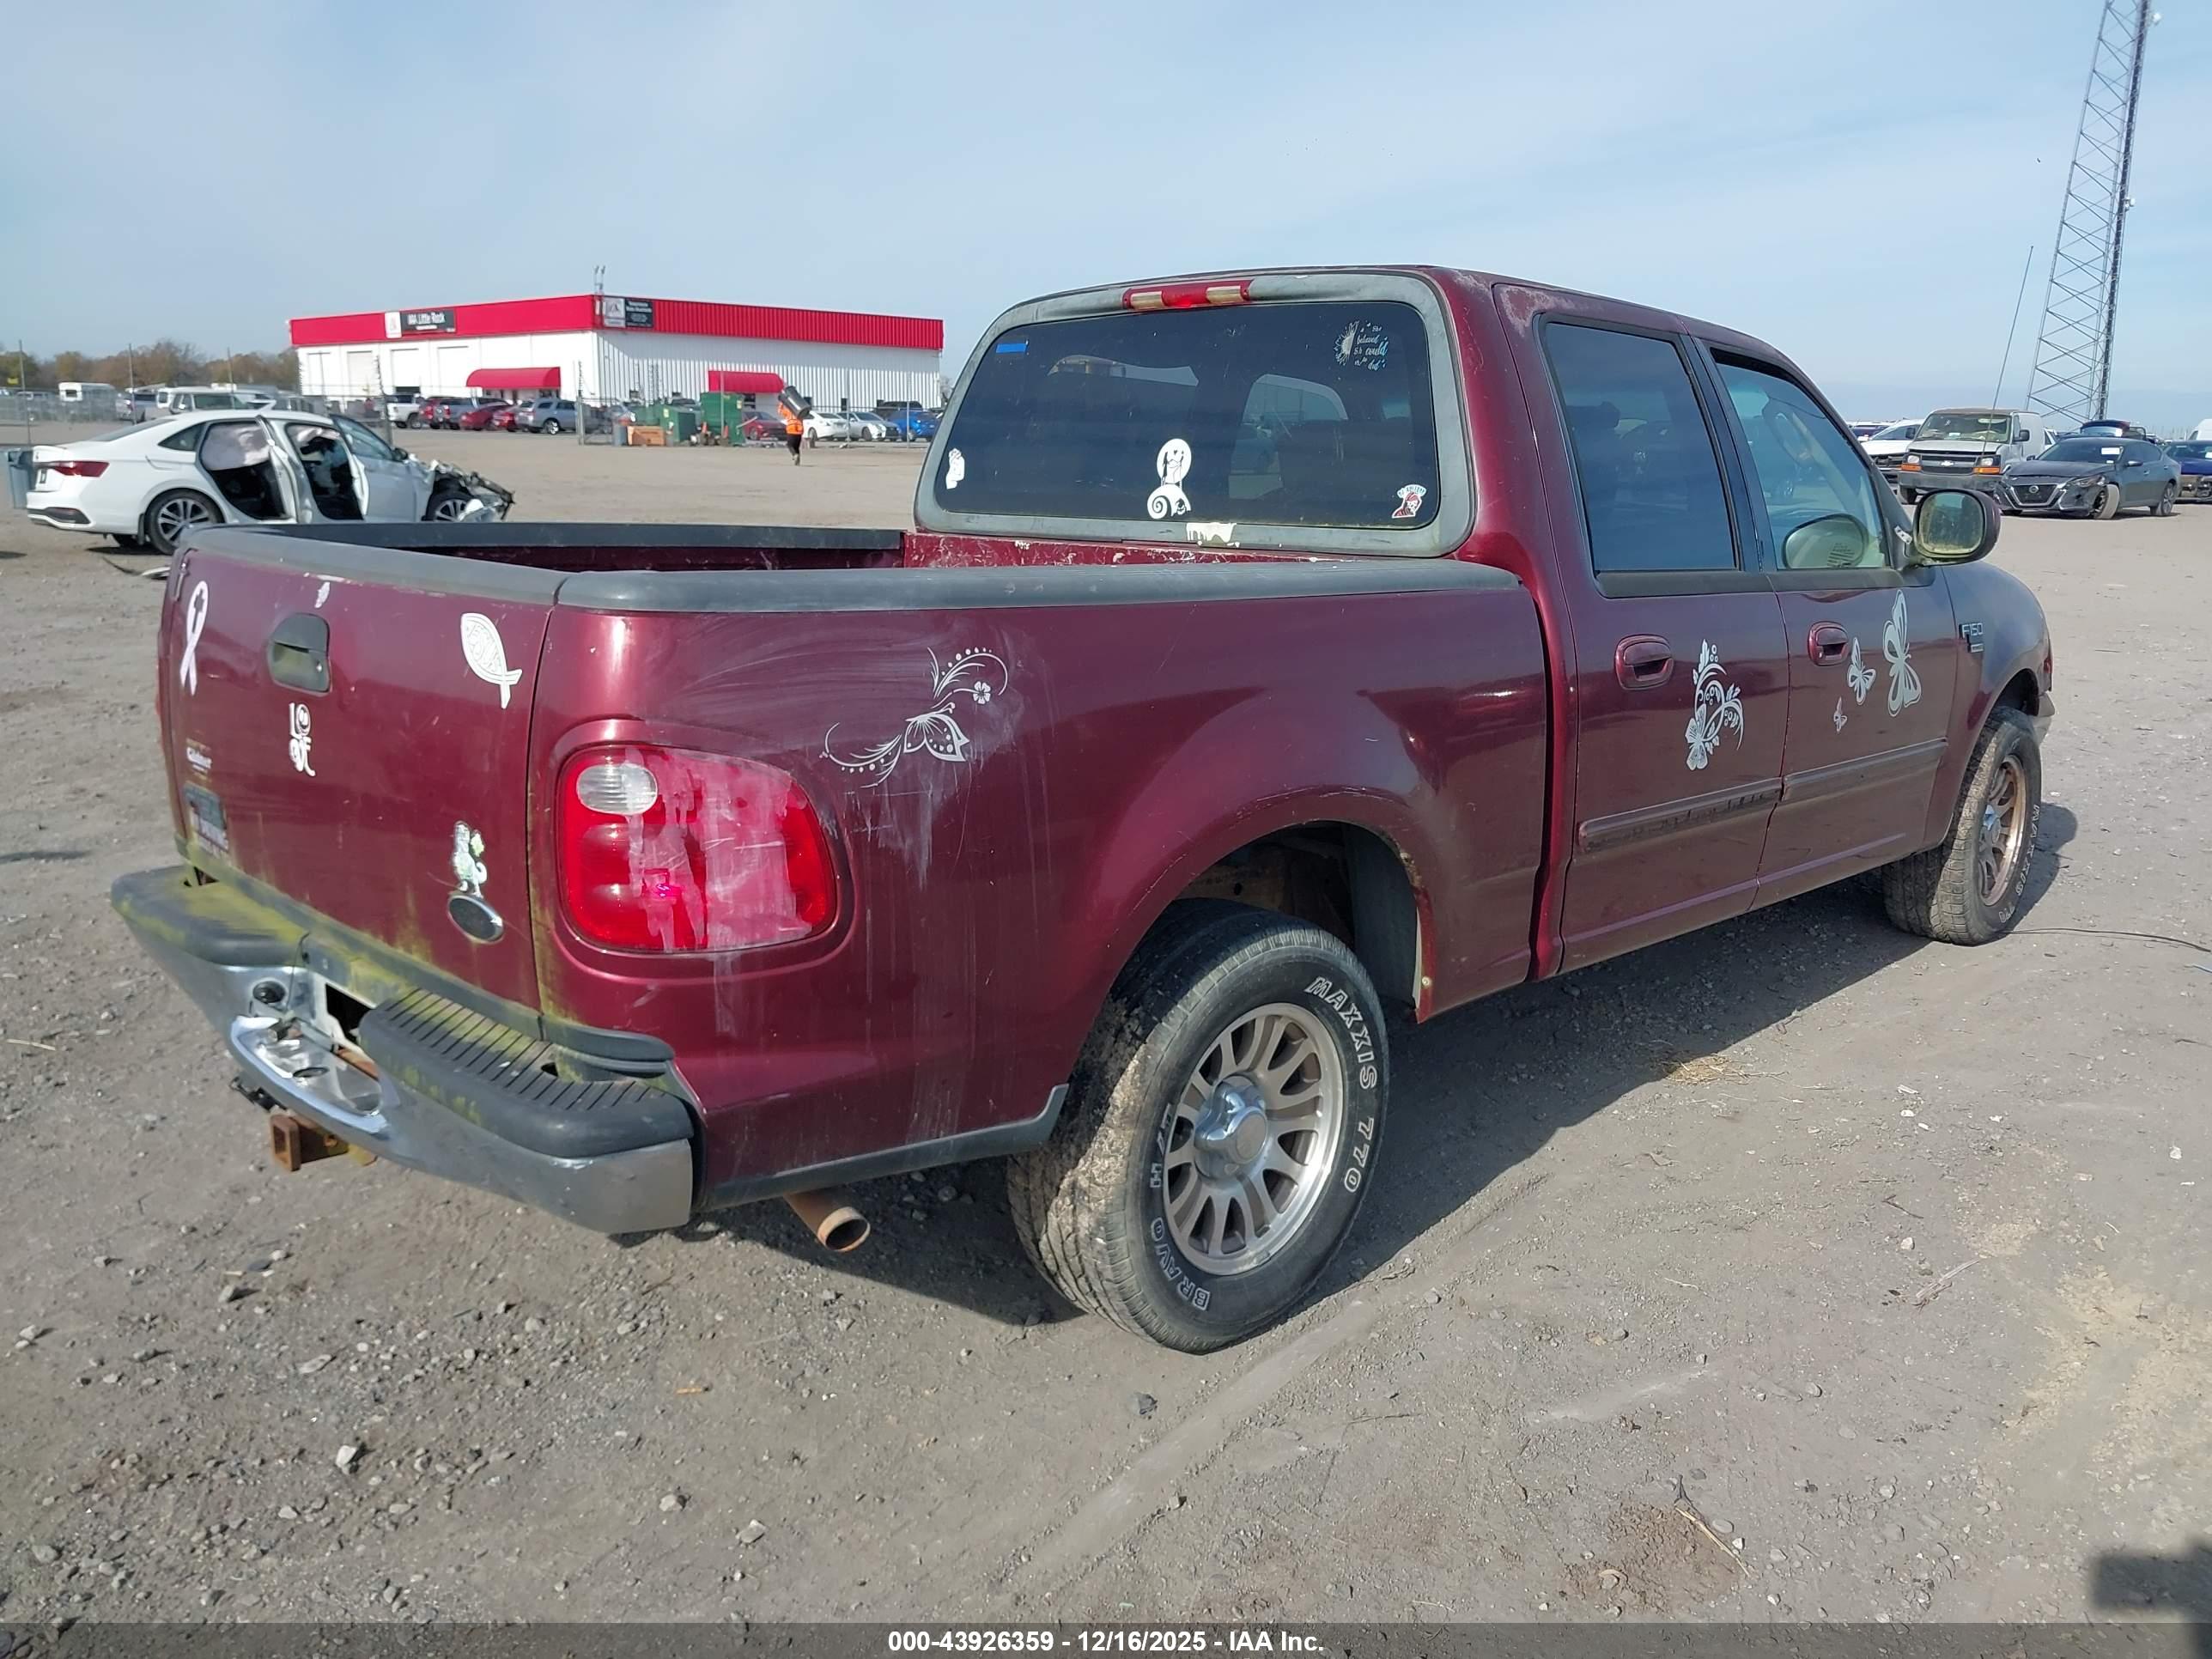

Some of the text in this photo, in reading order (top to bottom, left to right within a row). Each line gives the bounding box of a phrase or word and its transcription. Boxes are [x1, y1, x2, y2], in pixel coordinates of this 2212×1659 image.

[1304, 975, 1377, 1193] MAXXIS 770
[1151, 1217, 1211, 1311] BRAVO
